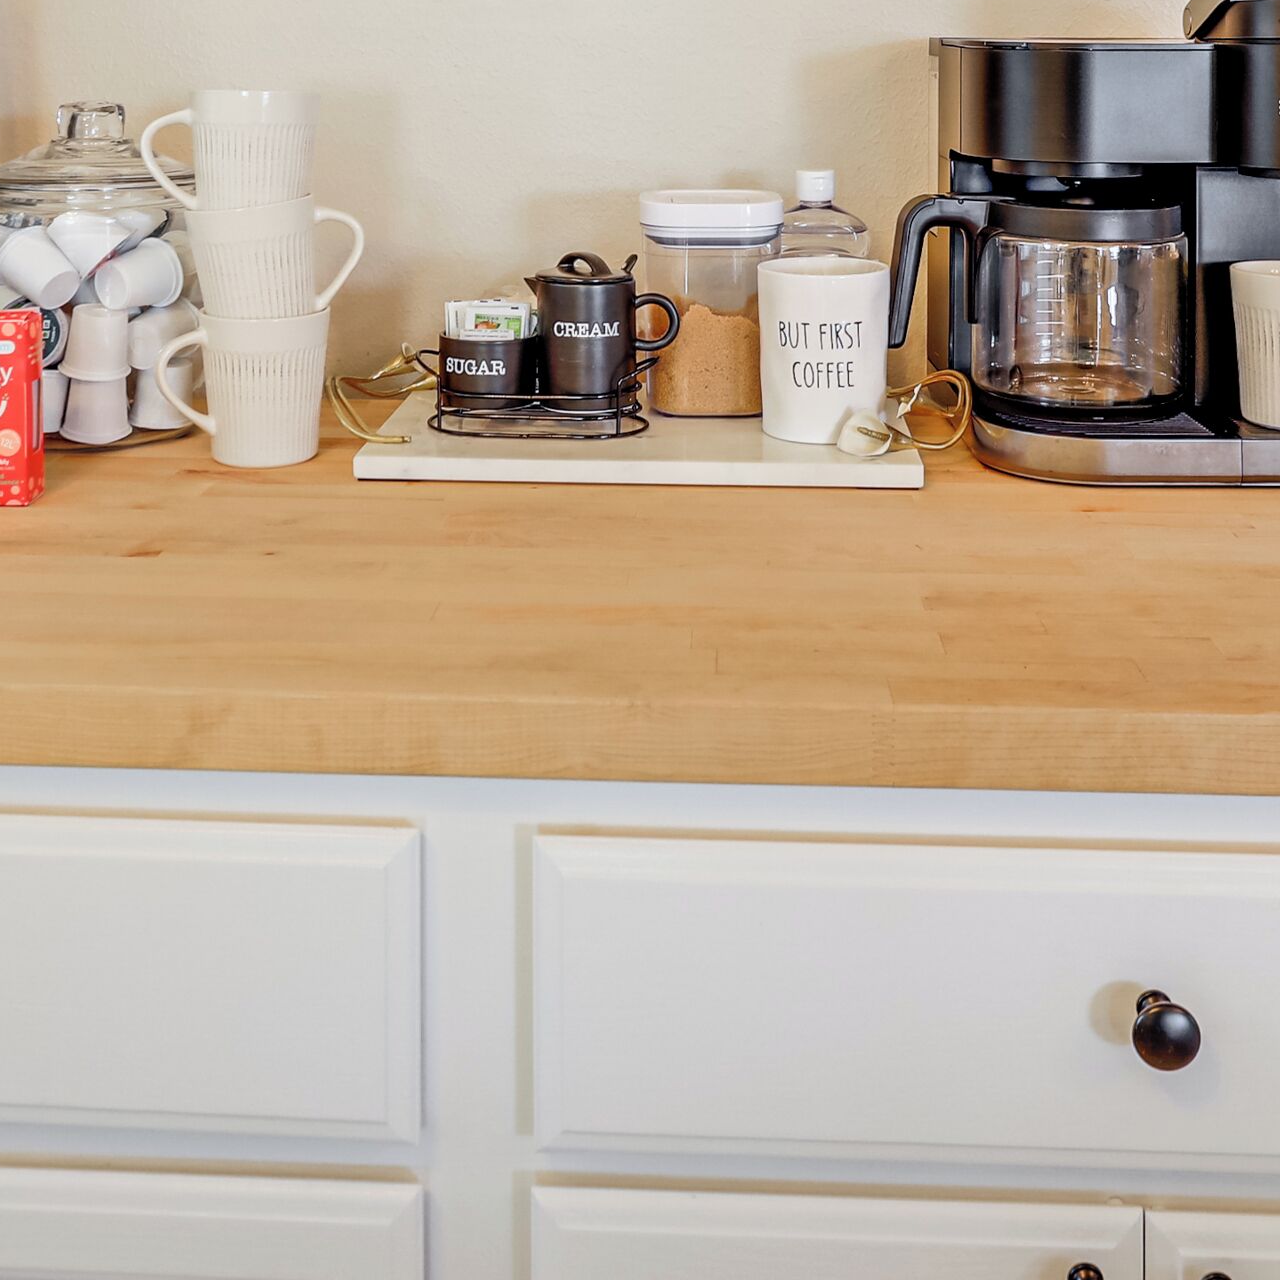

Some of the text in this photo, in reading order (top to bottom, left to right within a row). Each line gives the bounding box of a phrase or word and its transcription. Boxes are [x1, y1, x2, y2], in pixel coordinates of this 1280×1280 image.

[553, 321, 620, 338] CREAM
[779, 321, 862, 350] BUT FIRST
[446, 357, 506, 376] SUGAR
[792, 361, 854, 389] COFFEE
